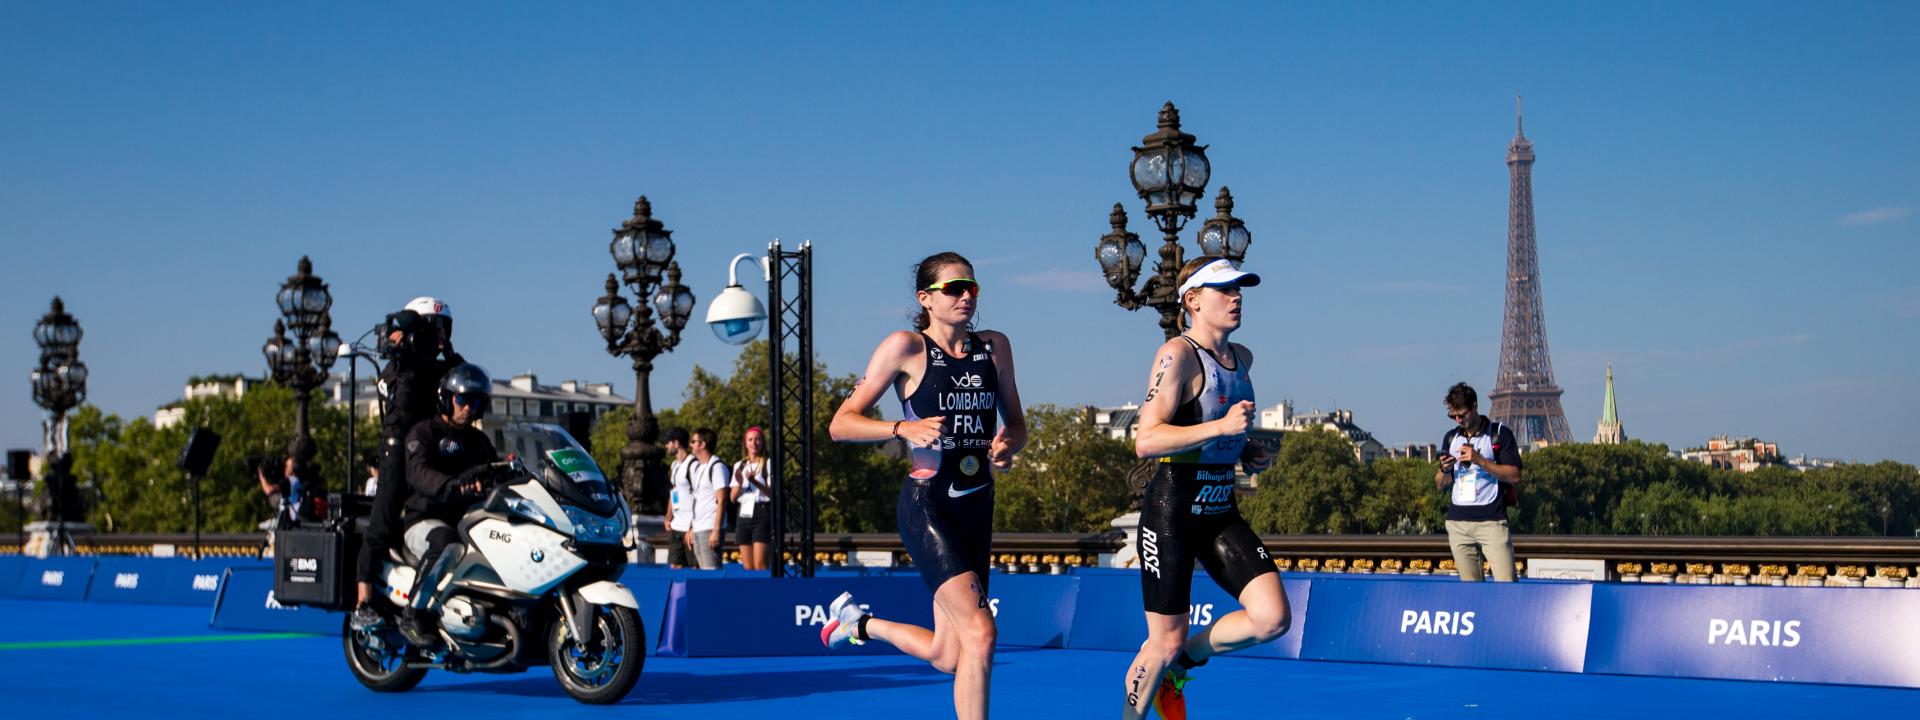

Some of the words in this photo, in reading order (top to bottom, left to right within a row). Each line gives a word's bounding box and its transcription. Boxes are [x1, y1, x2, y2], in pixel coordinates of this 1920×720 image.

[1145, 372, 1164, 402] 16
[938, 392, 995, 411] LOMBARDI
[953, 414, 985, 434] FRA
[489, 530, 512, 544] EMG
[1142, 526, 1160, 580] ROSE
[114, 572, 139, 590] PARIS
[192, 574, 219, 591] PARIS
[1401, 609, 1475, 636] PARIS
[1707, 618, 1801, 648] PARIS
[1127, 679, 1140, 707] 16
